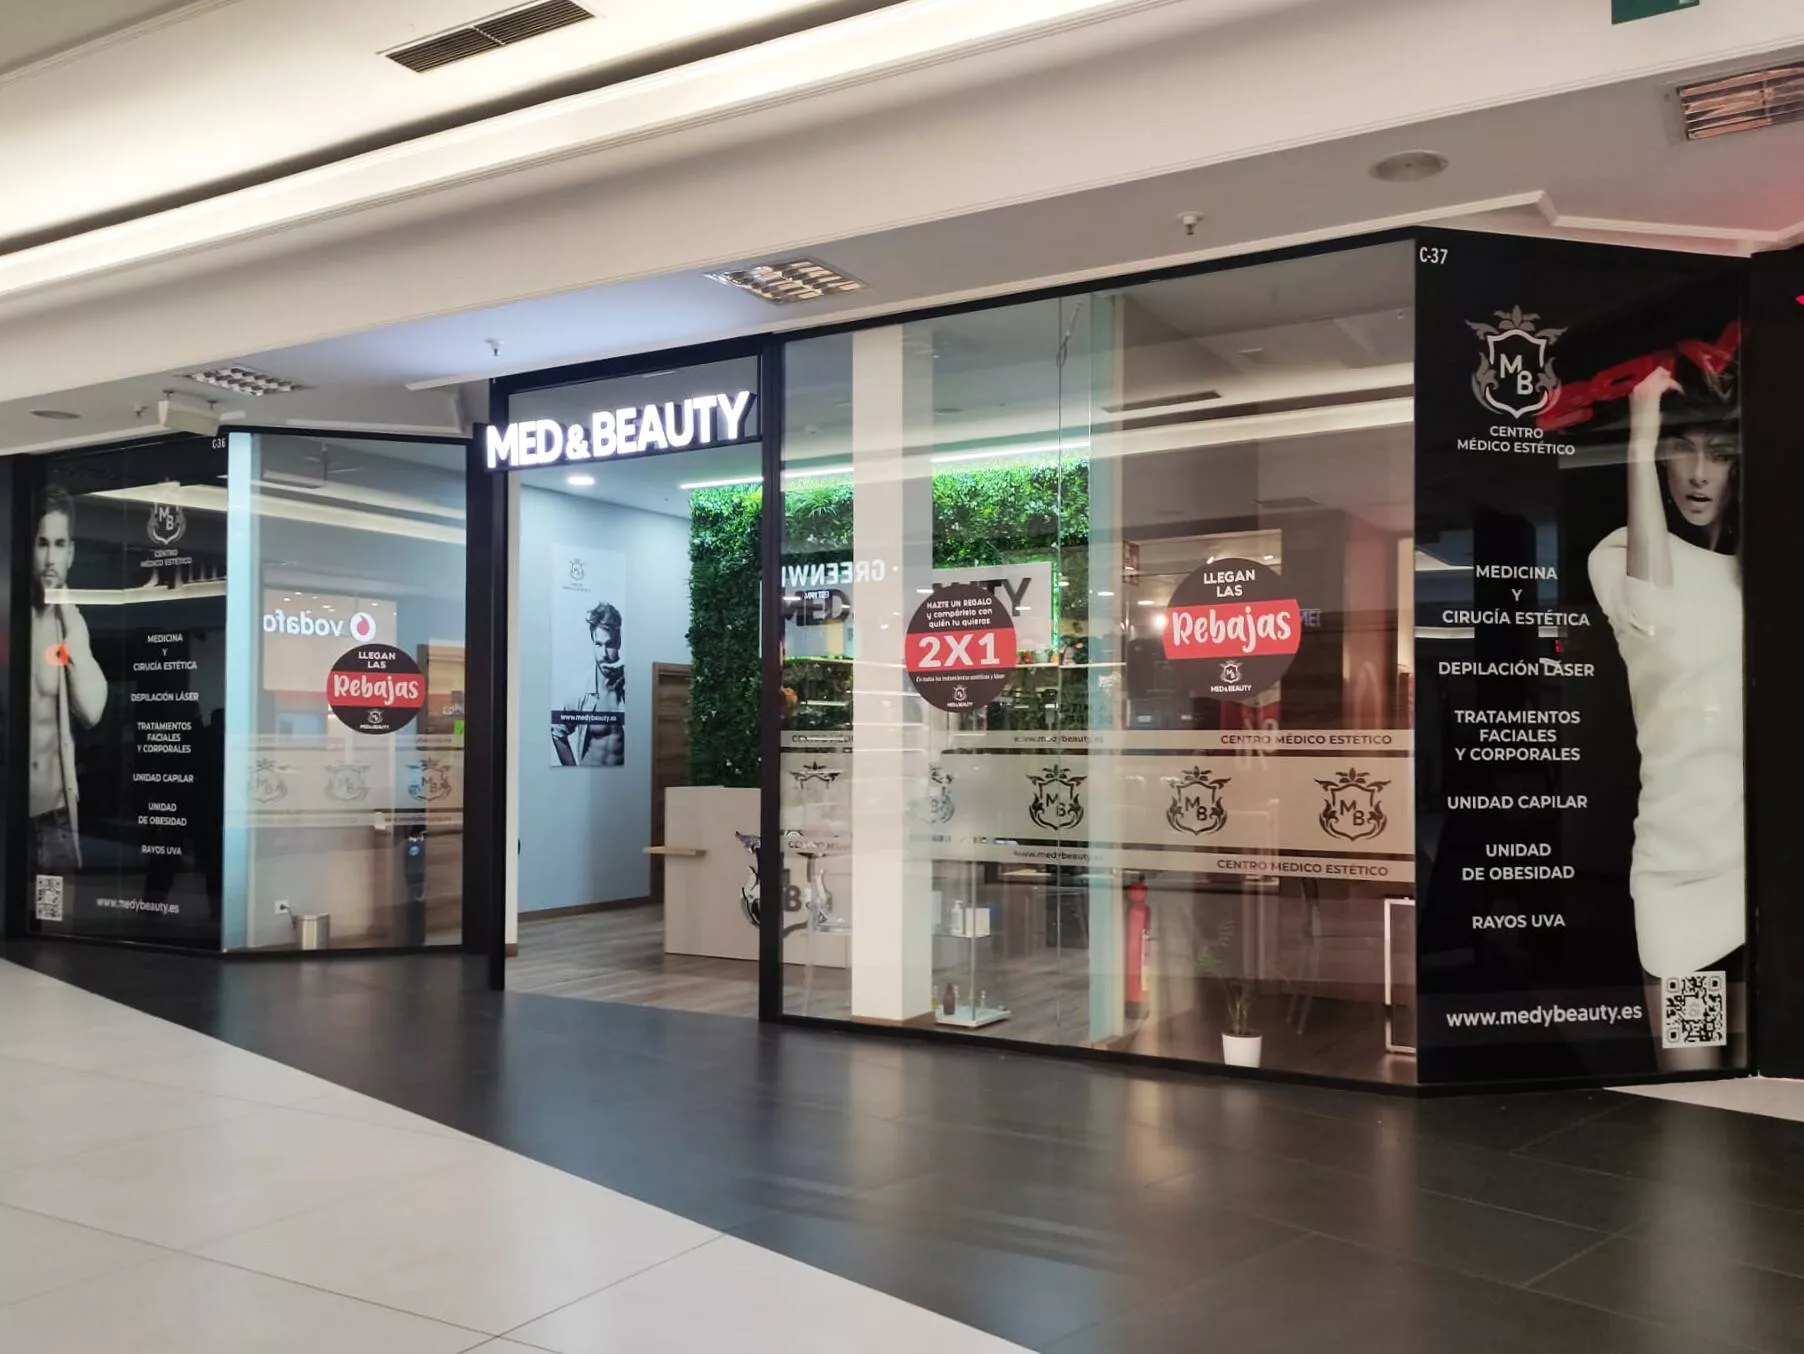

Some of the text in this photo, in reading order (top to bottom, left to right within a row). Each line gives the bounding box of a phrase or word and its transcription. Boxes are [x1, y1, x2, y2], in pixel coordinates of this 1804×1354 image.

[1419, 247, 1448, 265] C-37
[1490, 426, 1544, 439] CENTRO
[1457, 438, 1576, 456] MÉDICO ESTÉTICO
[1203, 569, 1256, 585] LLEGAN
[1476, 565, 1558, 580] MEDICINA
[1217, 585, 1243, 597] LAS
[1512, 589, 1523, 602] Y
[926, 598, 992, 609] HAZTE UN REGALO
[978, 608, 992, 616] con
[1442, 608, 1590, 626] CIRUGÍA ESTÉTICA
[1172, 606, 1292, 653] Rebajas
[147, 633, 183, 643] MEDICINA
[162, 648, 168, 656] Y
[358, 651, 396, 660] LLEGAN
[918, 632, 1000, 668] 2X1
[368, 660, 386, 668] LAS
[1438, 660, 1595, 677] DEPILACIÓN LÁSER
[131, 691, 199, 702] DEPILACIÓN LÁSER
[333, 674, 418, 706] Rebajas
[1454, 710, 1581, 724] TRATAMIENTOS
[137, 722, 192, 730] TRATAMIENTOS
[147, 733, 181, 742] FACIALES
[1221, 735, 1271, 744] CENTRO
[1480, 729, 1557, 743] FACIALES
[143, 745, 191, 753] CORPORALES
[1455, 748, 1581, 761] Y CORPORALES
[133, 774, 194, 782] UNIDAD CAPILAR
[148, 802, 177, 811] UNIDAD
[1448, 796, 1588, 810] UNIDAD CAPILAR
[138, 816, 187, 826] DE OBESIDAD
[142, 844, 182, 855] RAYOS UVA
[1486, 844, 1552, 858] UNIDAD
[1217, 860, 1267, 870] CENTRO
[1462, 866, 1575, 881] DE OBESIDAD
[1472, 914, 1566, 929] RAYOS UVA
[1446, 1004, 1642, 1028] www.medybeauty.es
